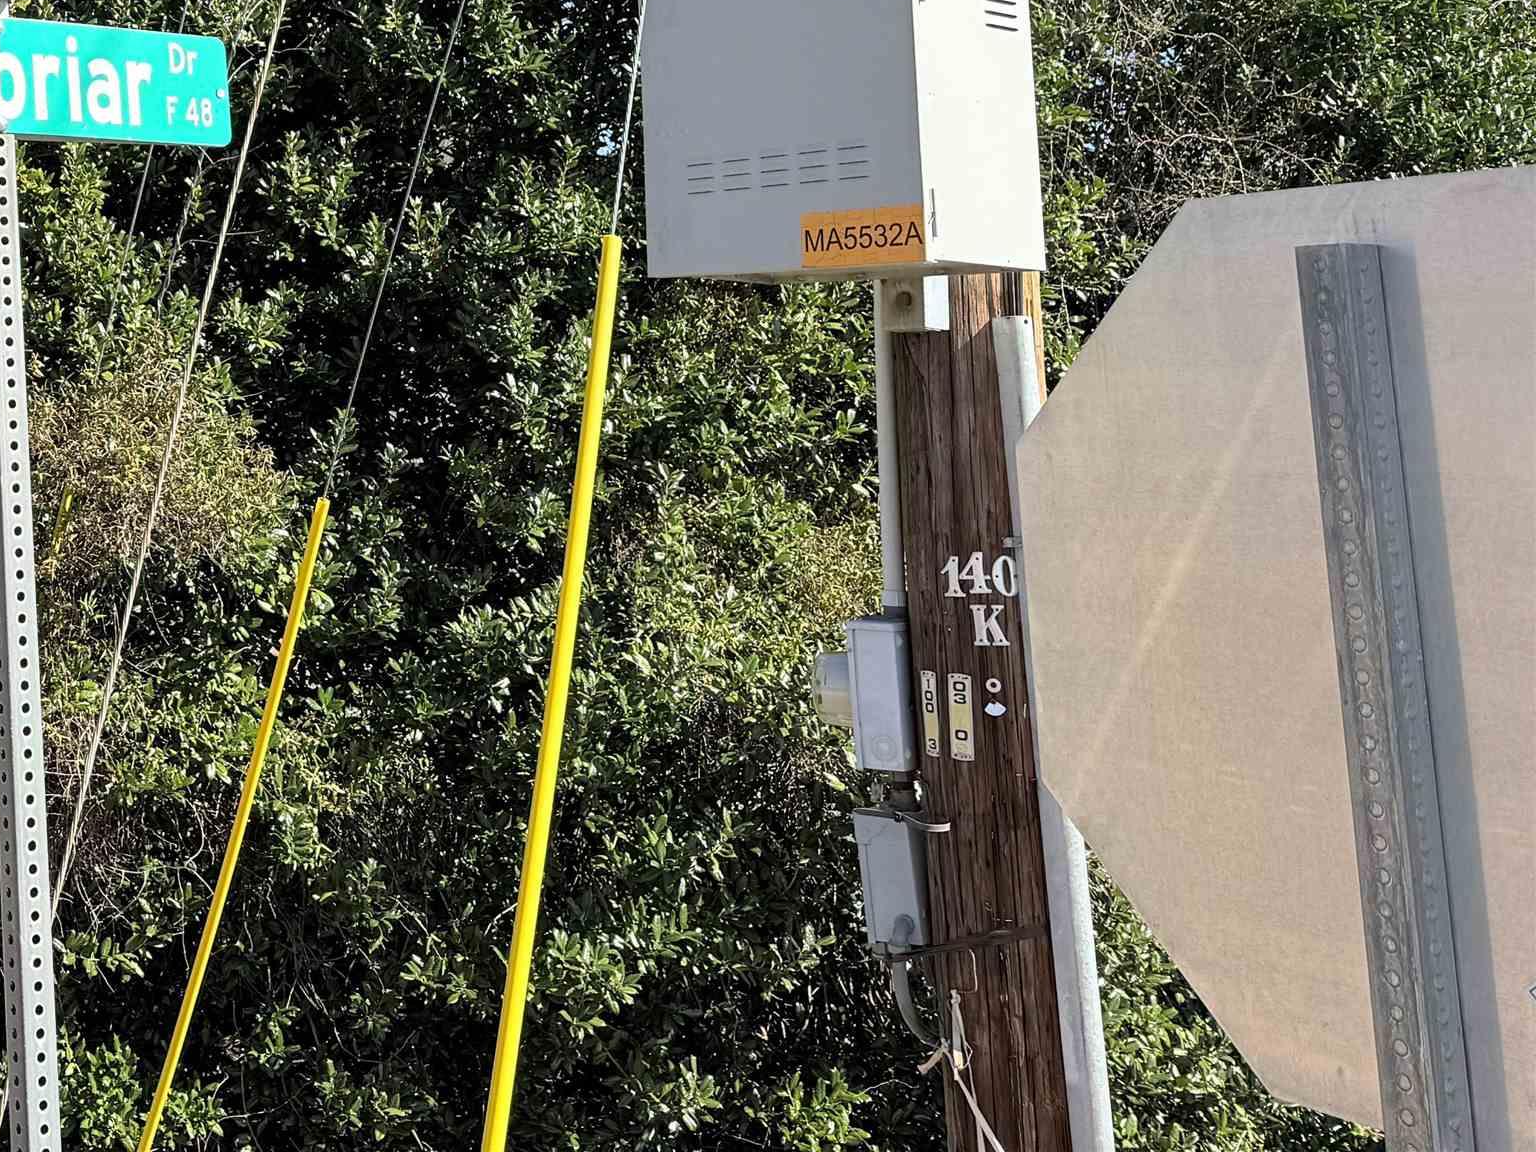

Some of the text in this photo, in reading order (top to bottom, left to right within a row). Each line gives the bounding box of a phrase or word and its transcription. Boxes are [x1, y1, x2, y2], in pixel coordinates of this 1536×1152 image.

[167, 42, 199, 77] Dr
[166, 95, 214, 128] F 48
[804, 221, 923, 253] MA5532A
[940, 551, 1019, 597] 140
[969, 604, 1011, 646] K
